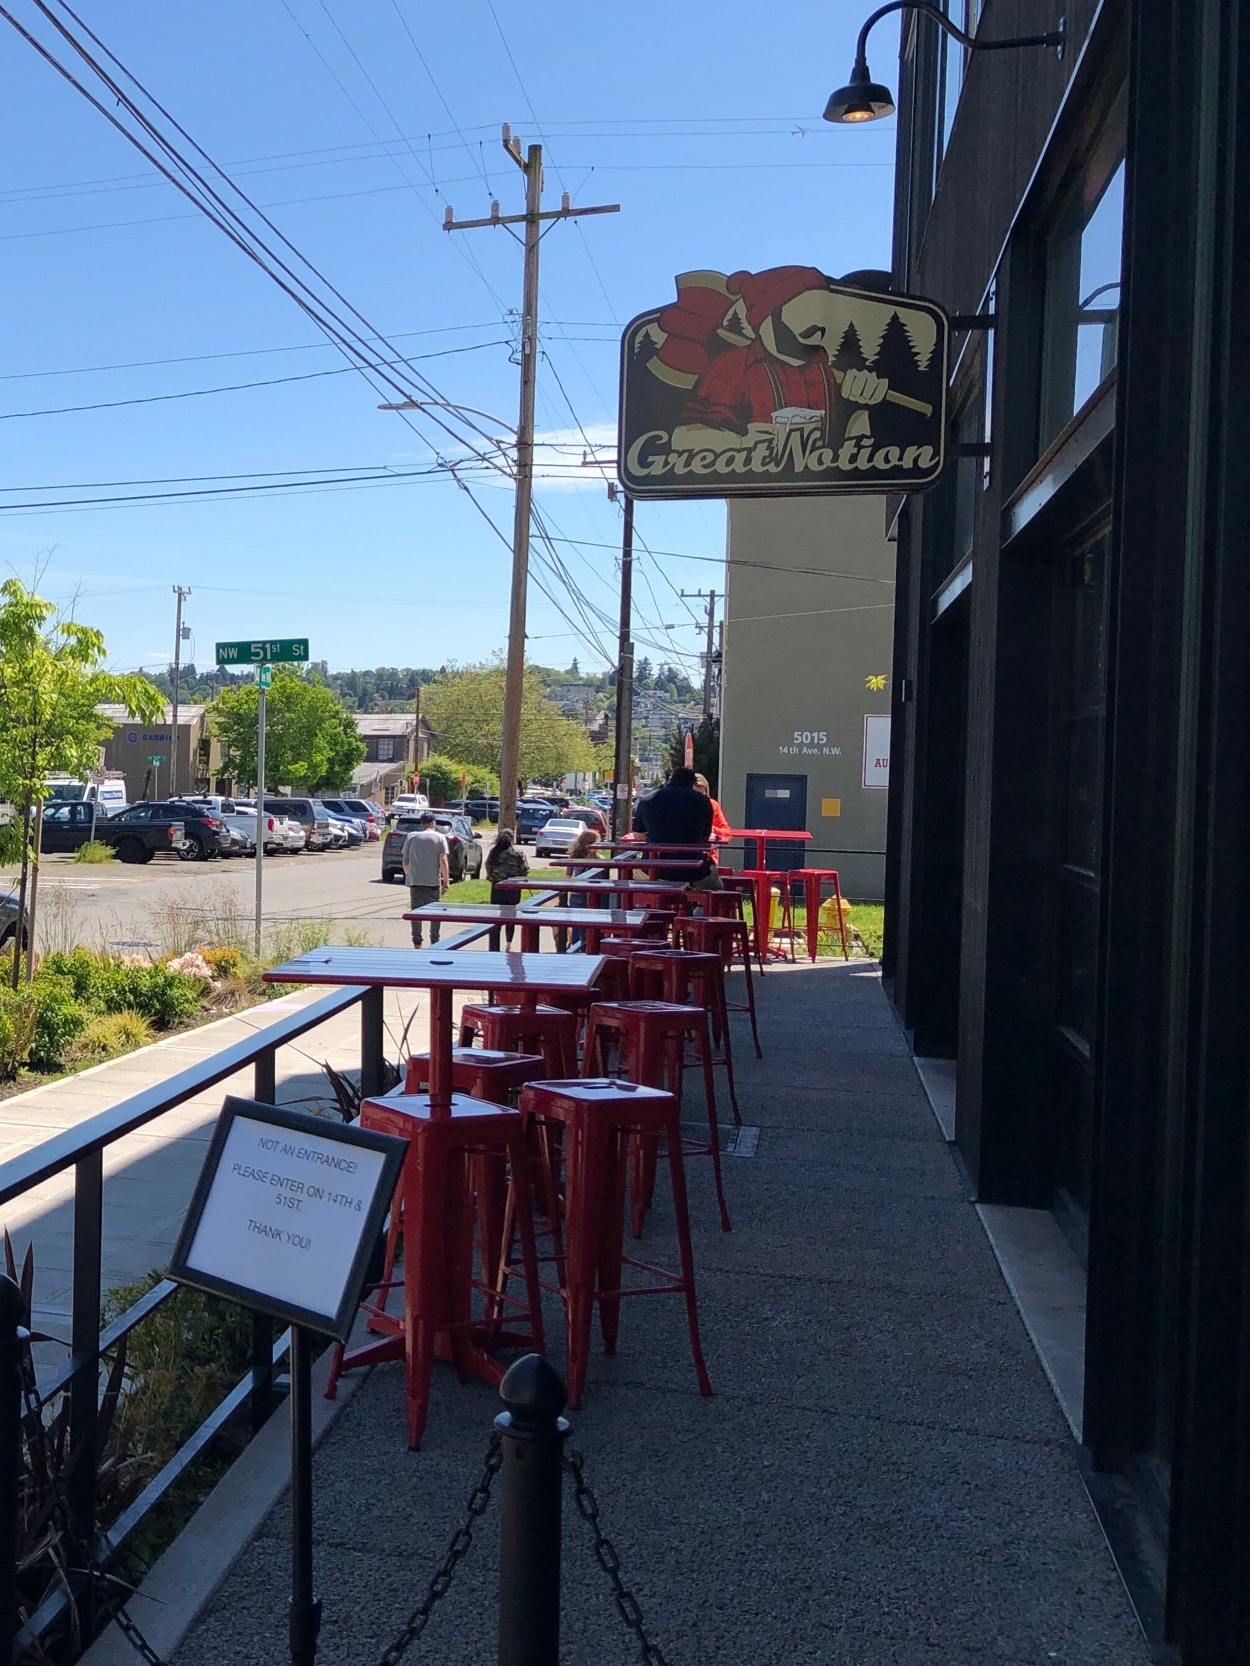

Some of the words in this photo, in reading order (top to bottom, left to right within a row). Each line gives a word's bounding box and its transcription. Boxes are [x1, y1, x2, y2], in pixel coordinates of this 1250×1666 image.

[627, 430, 784, 476] Great
[775, 427, 941, 473] Notion
[219, 647, 238, 659] NW
[250, 643, 281, 660] 51st
[292, 644, 305, 656] St
[793, 731, 827, 744] 5015
[779, 746, 799, 754] 14th
[801, 747, 821, 755] Ave.
[822, 747, 842, 755] N.W.
[257, 1137, 282, 1150] NOT
[279, 1143, 296, 1157] AN
[296, 1147, 358, 1174] ENTRANCE!
[232, 1163, 269, 1183] PLEASE
[269, 1174, 305, 1194] ENTER
[306, 1185, 325, 1200] ON
[327, 1191, 353, 1208] 14TH
[354, 1199, 363, 1212] &
[275, 1193, 303, 1211] 51ST.
[247, 1218, 284, 1241] THANK
[285, 1231, 312, 1250] YOU!
